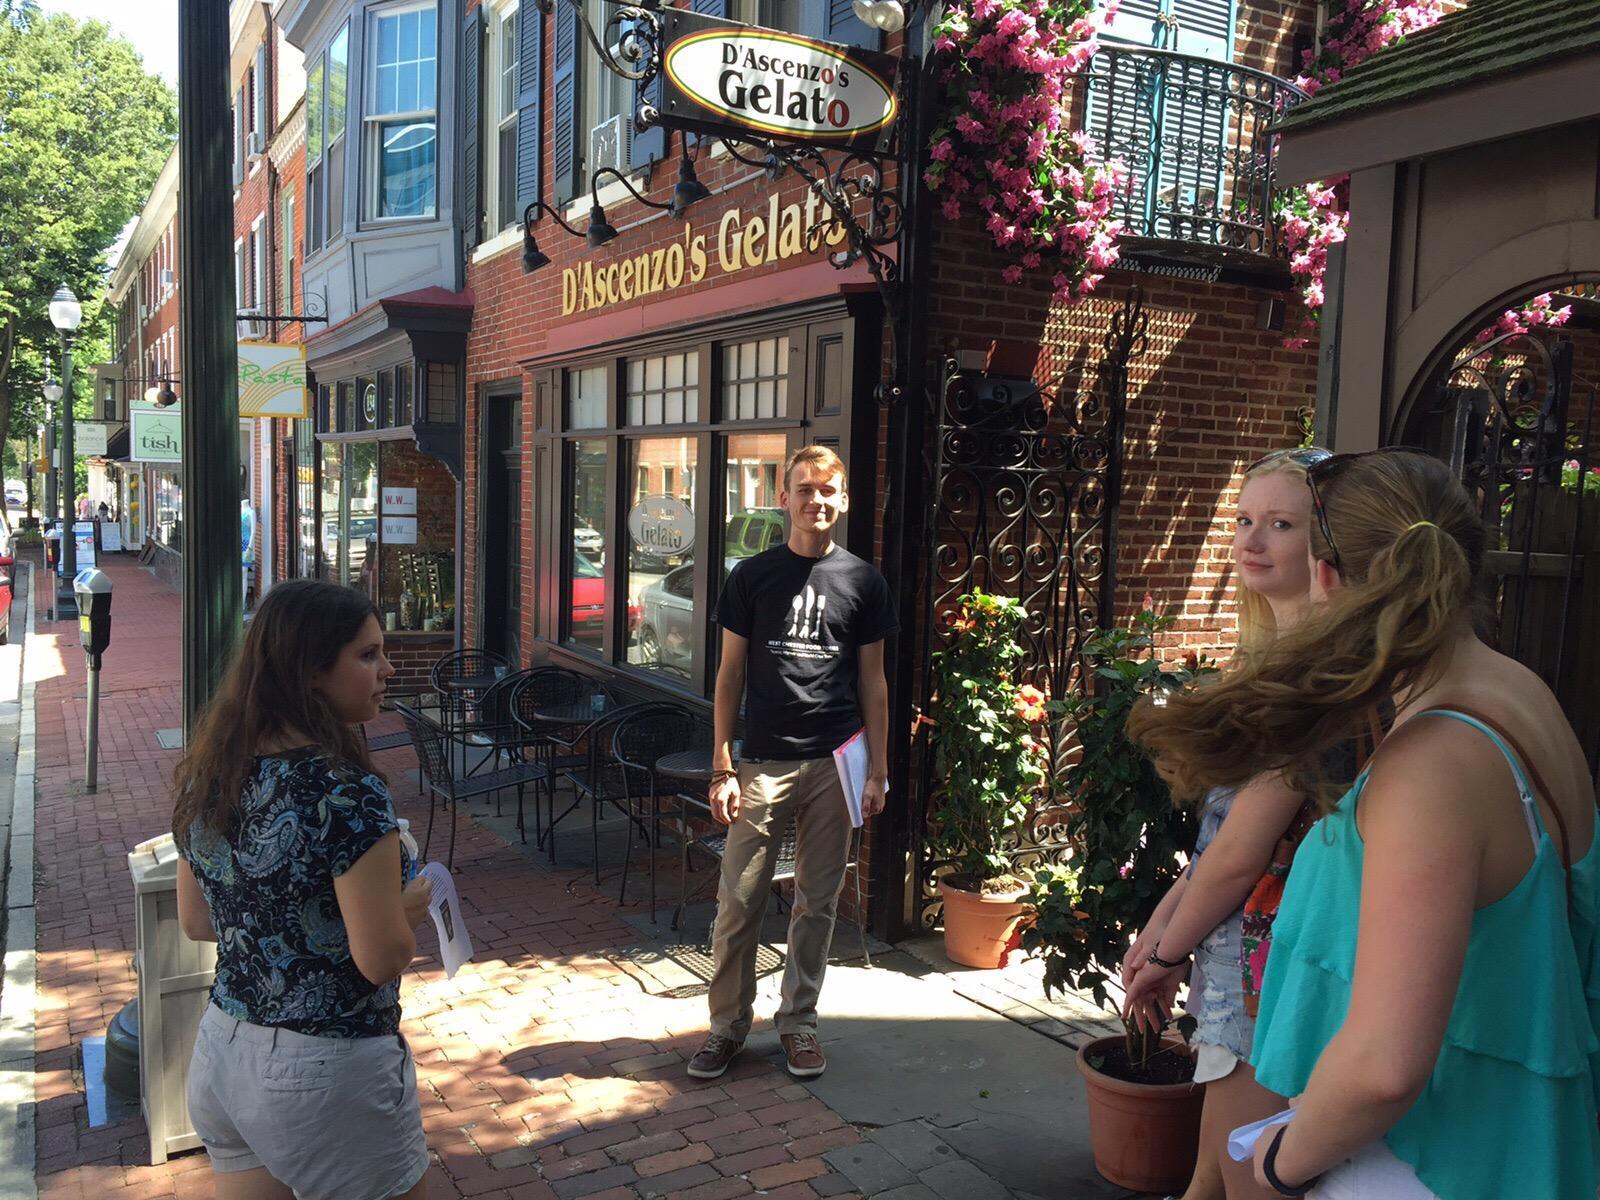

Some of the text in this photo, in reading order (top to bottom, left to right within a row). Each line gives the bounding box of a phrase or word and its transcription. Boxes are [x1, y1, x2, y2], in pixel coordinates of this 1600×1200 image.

[721, 41, 850, 88] D'Ascenzo's
[718, 69, 850, 128] Gelato
[562, 186, 848, 316] D'Ascenzo's Gelato
[240, 363, 306, 386] Pasta
[141, 434, 181, 454] tish
[641, 521, 682, 549] Gelato
[782, 641, 806, 650] CHESTER
